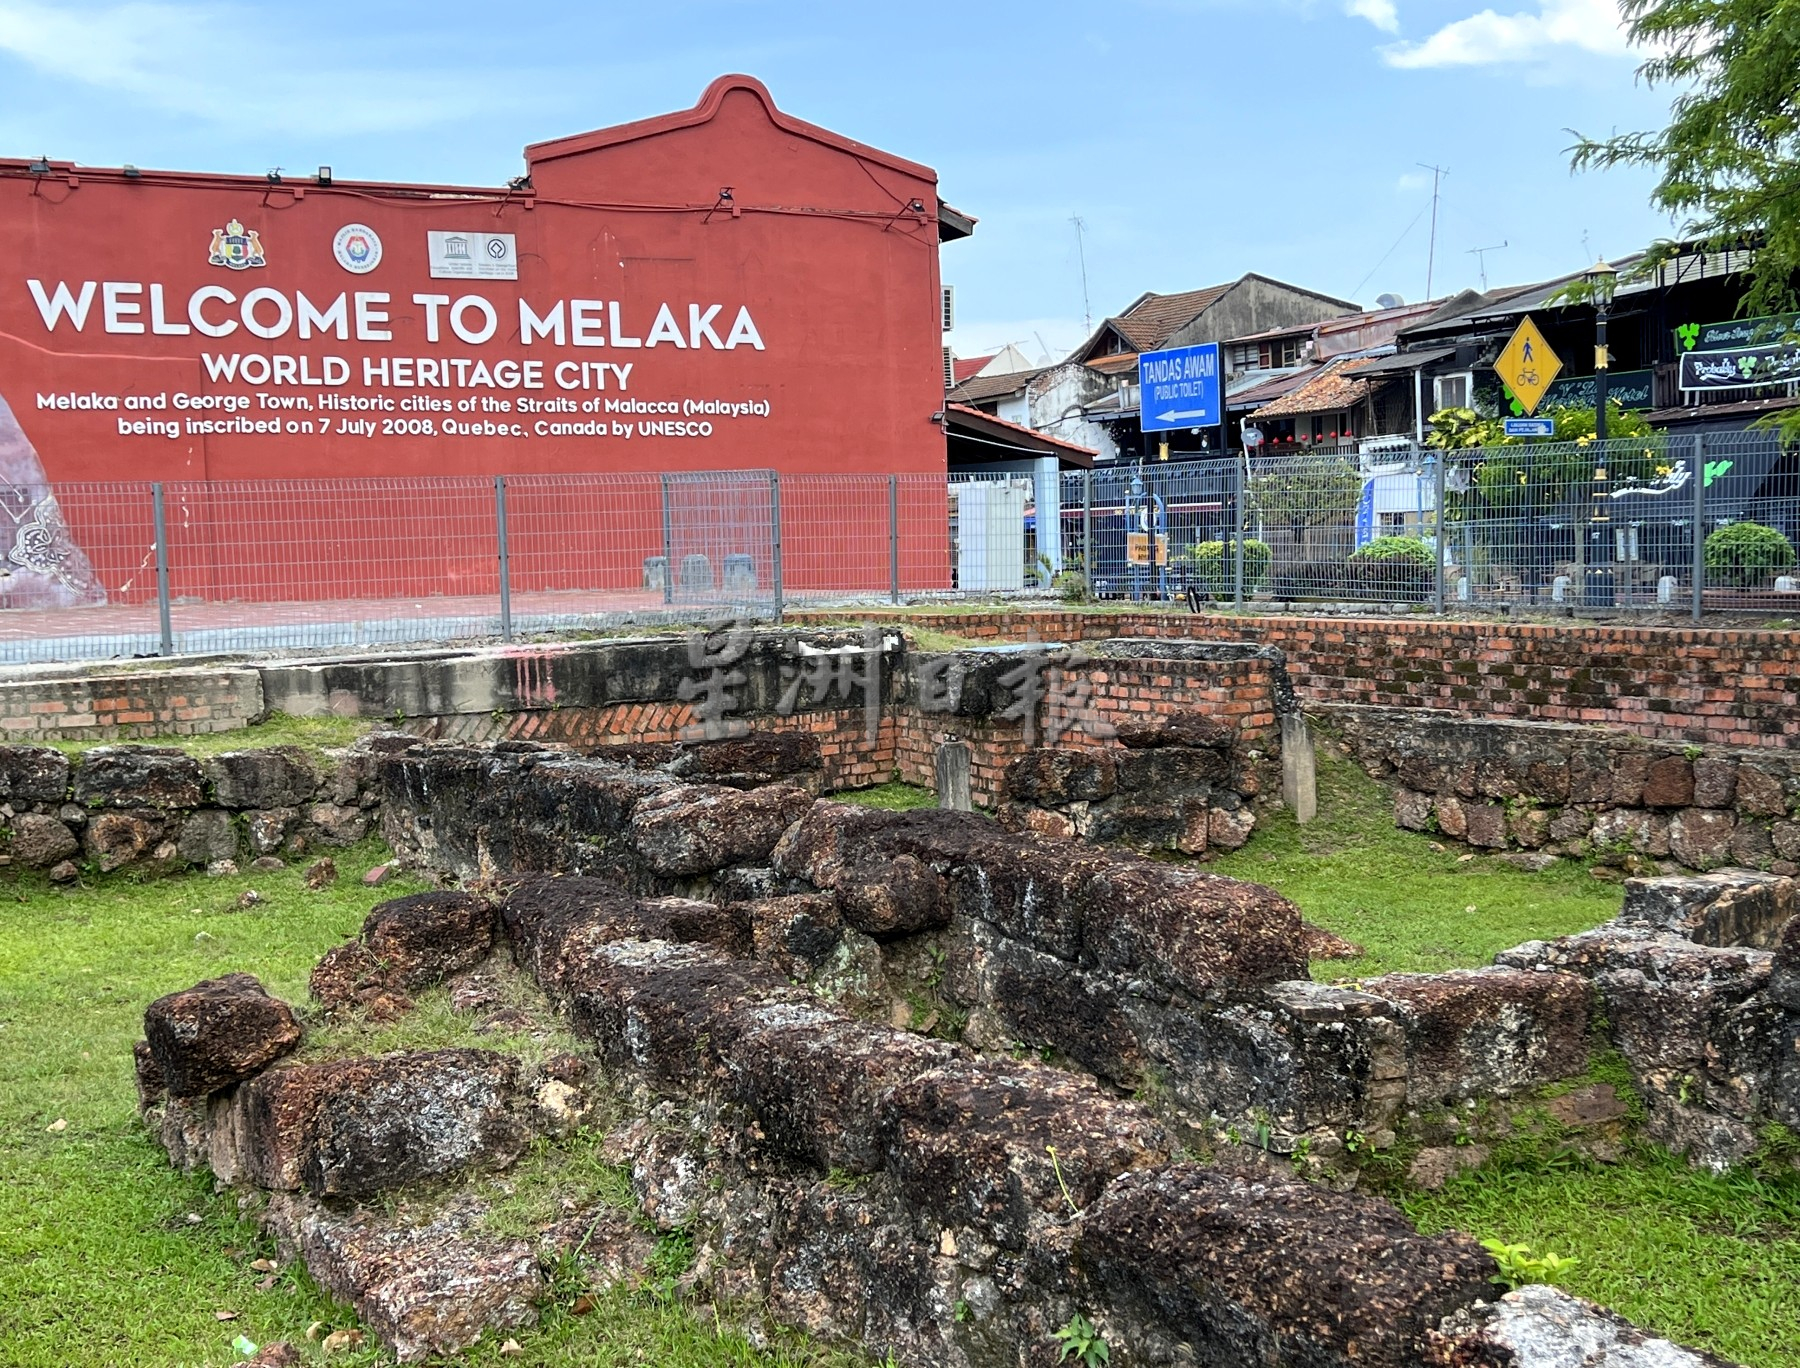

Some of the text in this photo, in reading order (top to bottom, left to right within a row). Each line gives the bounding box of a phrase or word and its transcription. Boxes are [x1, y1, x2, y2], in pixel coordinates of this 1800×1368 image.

[26, 279, 766, 351] WELCOME TO MELAKA
[201, 352, 634, 391] WORLD HERITAGE CITY
[1143, 353, 1214, 384] TANDAS AWAM
[36, 391, 771, 418] Melaka and George Town, Historic cities of the Straits of Malacca (Malaysia)
[1154, 380, 1204, 404] (PUBLIC TOILET)
[117, 415, 713, 439] being inscribed on 7 July 2008, Quebec, Canada by UNESCO
